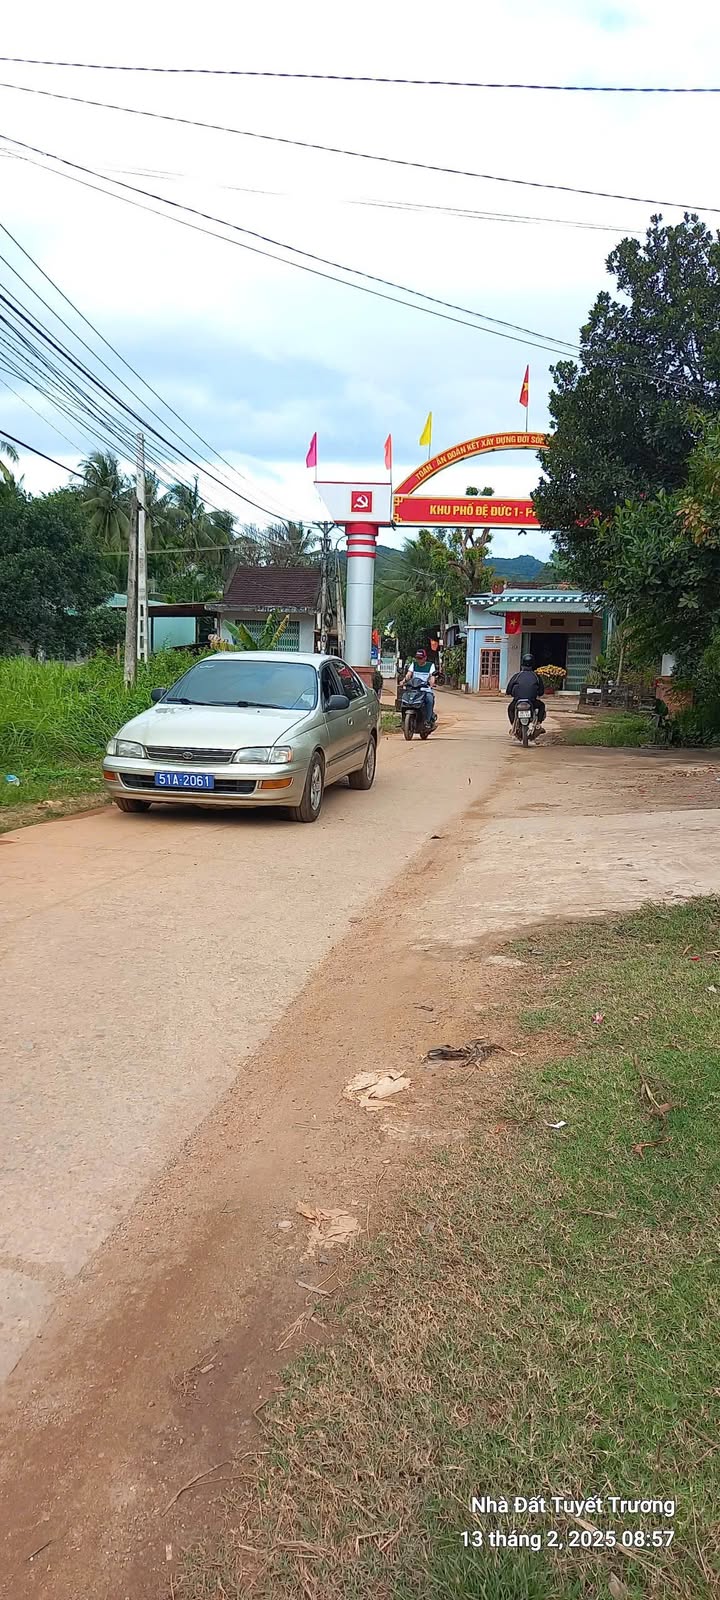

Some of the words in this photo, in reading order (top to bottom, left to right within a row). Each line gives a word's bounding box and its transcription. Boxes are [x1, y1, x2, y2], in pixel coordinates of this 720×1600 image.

[429, 504, 451, 515] KHU
[452, 501, 474, 516] PHỐ
[475, 503, 489, 519] ĐỆ
[490, 503, 512, 517] ĐỨC
